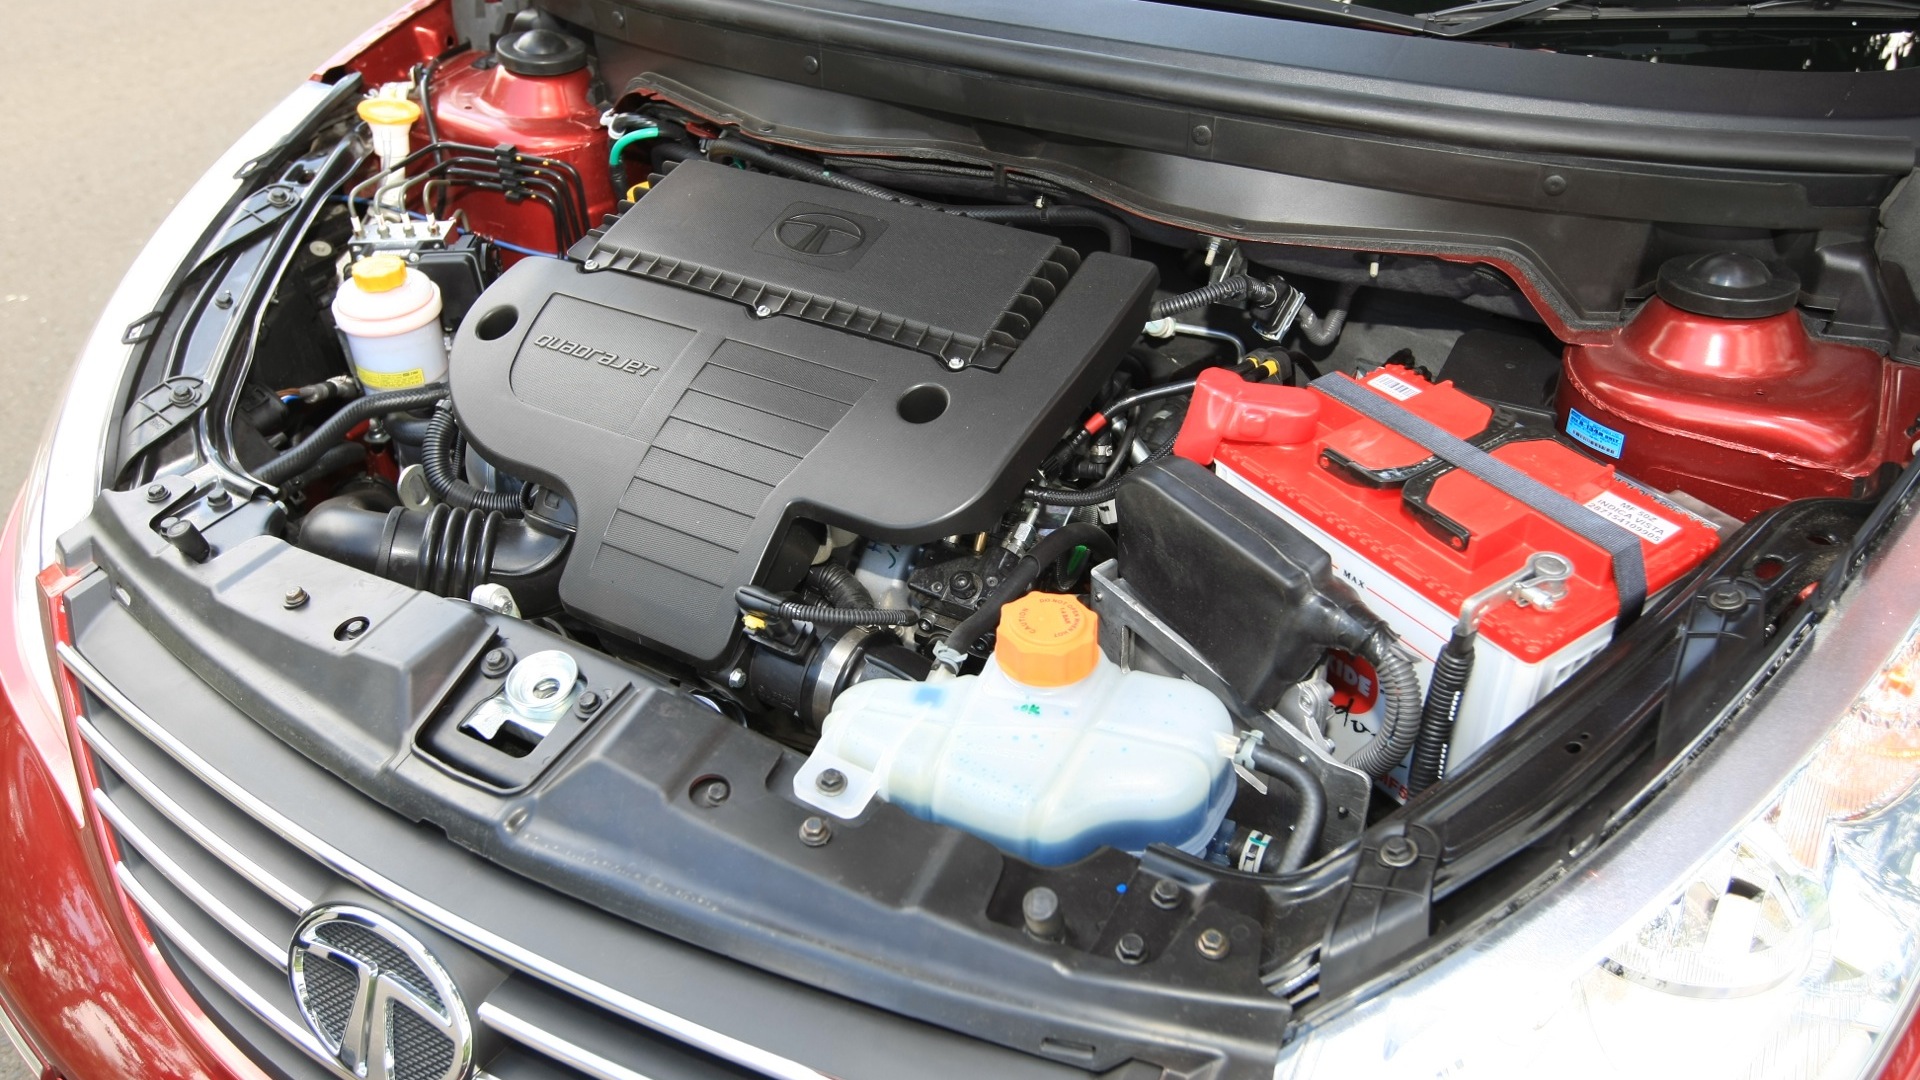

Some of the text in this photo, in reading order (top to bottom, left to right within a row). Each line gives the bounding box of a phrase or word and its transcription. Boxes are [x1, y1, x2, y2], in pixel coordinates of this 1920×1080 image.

[1597, 499, 1665, 536] INDICA VISTA
[1620, 502, 1638, 512] MF
[1343, 569, 1365, 589] MAX
[1018, 607, 1037, 635] CAUTION
